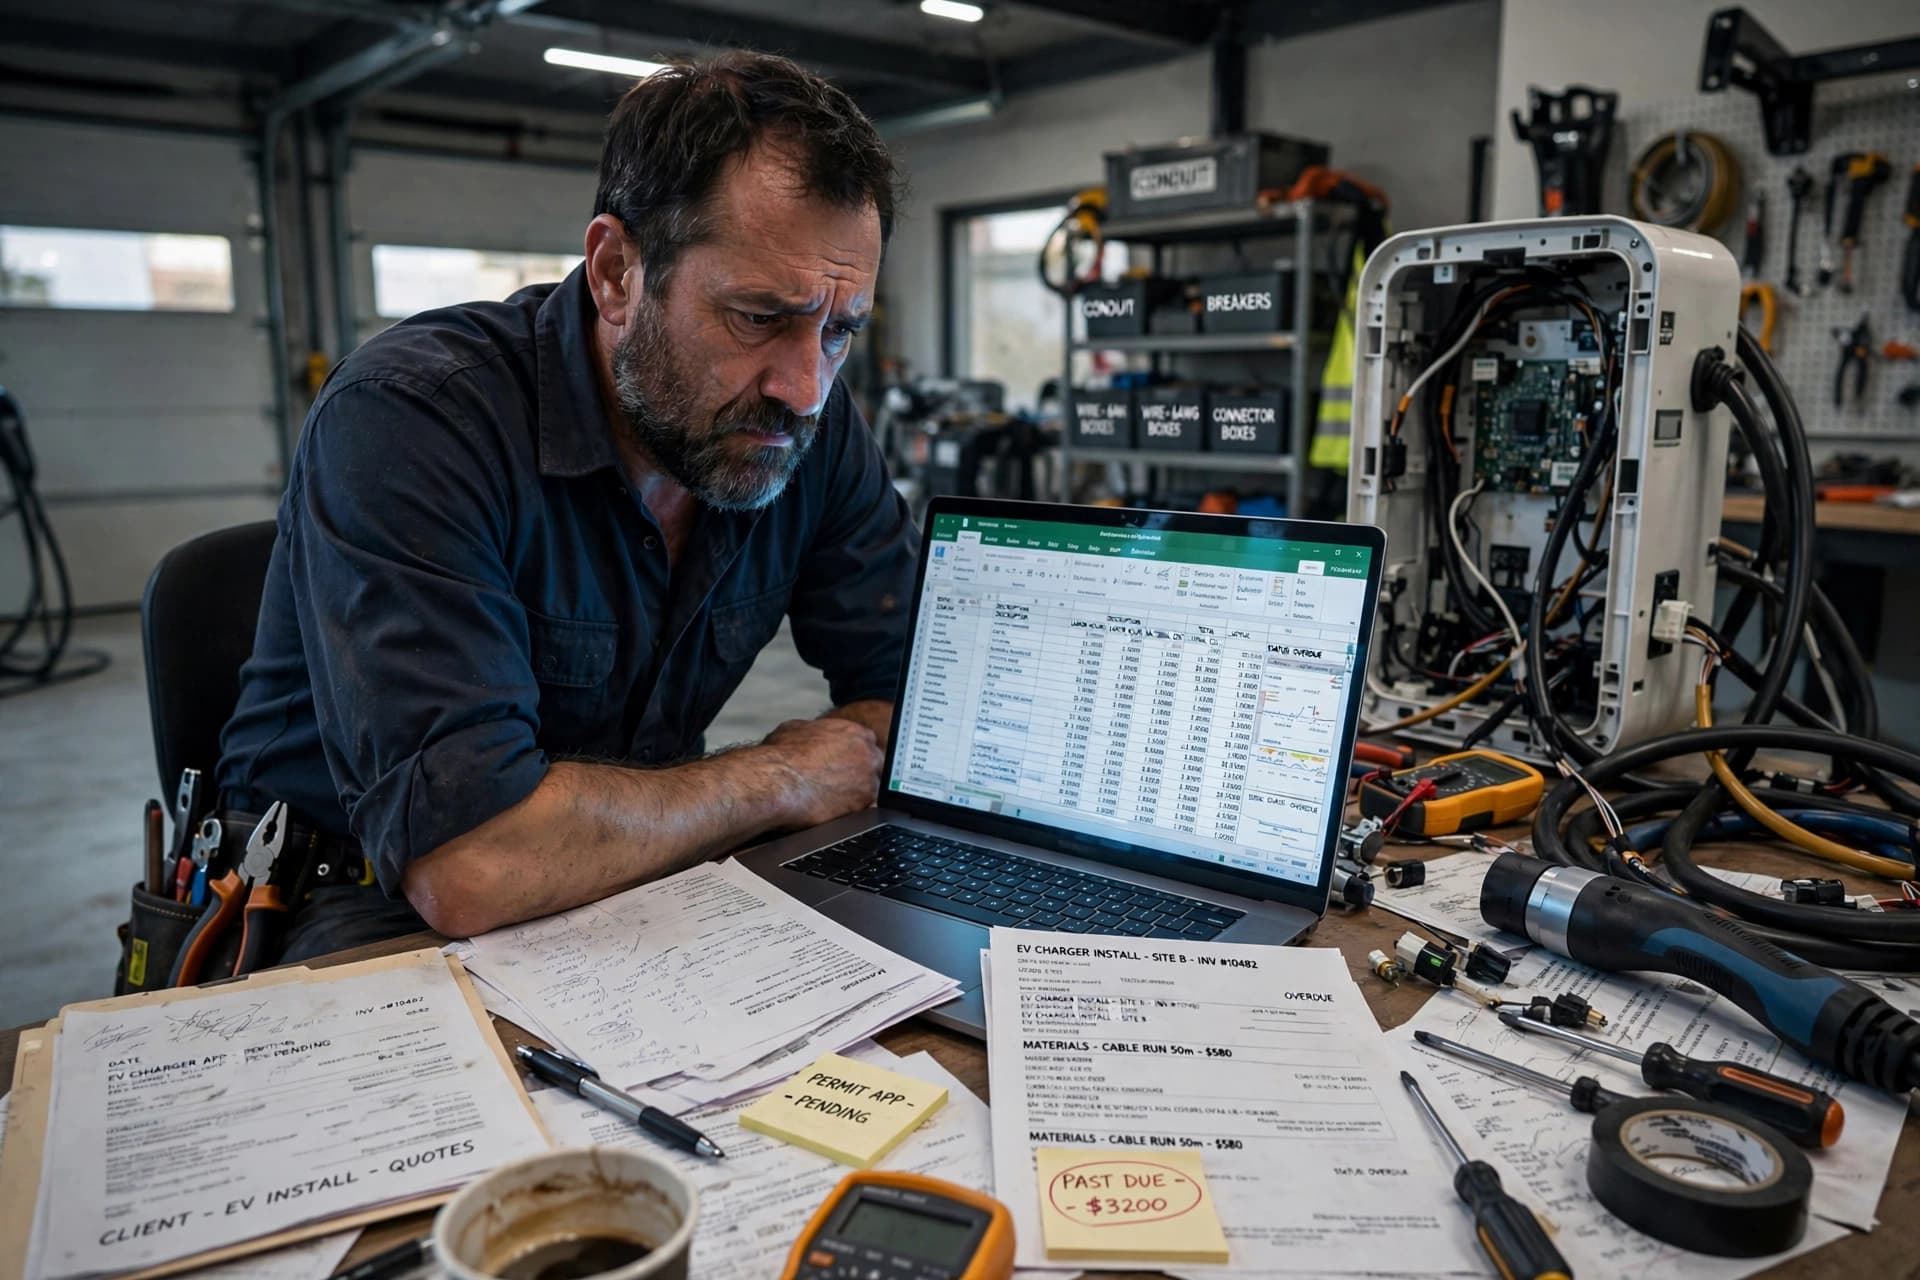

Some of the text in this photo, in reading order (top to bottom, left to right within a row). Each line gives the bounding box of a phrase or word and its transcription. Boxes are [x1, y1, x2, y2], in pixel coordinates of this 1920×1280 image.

[1207, 292, 1272, 312] BREAKERS
[1213, 407, 1276, 423] CONNECTOR
[1148, 421, 1181, 437] BOXES
[1221, 425, 1256, 441] BOXES
[1017, 944, 1031, 953] EV
[1034, 945, 1090, 957] CHARGER
[1093, 949, 1141, 961] INSTALL
[1152, 952, 1176, 963] SITE
[1179, 954, 1187, 964] B
[1197, 956, 1216, 966] INV
[1220, 958, 1258, 969] #10482
[1284, 991, 1335, 1003] OVERDUE
[355, 1007, 375, 1016] INV
[1023, 1040, 1089, 1051] MATERIALS
[1102, 1043, 1139, 1053] CABLE
[1143, 1044, 1167, 1054] RUN
[1171, 1045, 1194, 1055] 50m
[1206, 1047, 1233, 1058] $580
[108, 1072, 125, 1082] EV
[273, 1039, 332, 1057] PENDING
[108, 1057, 141, 1068] DATE
[807, 1073, 871, 1096] PERMIT
[868, 1090, 906, 1105] APP
[794, 1095, 871, 1123] PENDING
[1029, 1131, 1096, 1144] MATERIALS
[1108, 1135, 1148, 1146] CABLE
[1150, 1136, 1176, 1147] RUN
[1179, 1137, 1203, 1148] 50m
[1062, 1173, 1114, 1190] PAST
[1124, 1173, 1167, 1188] DUE
[99, 1211, 193, 1247] CLIENT
[224, 1197, 256, 1216] EV
[266, 1172, 359, 1206] INSTALL
[388, 1140, 475, 1173] QUOTES
[1086, 1196, 1168, 1216] $3200
